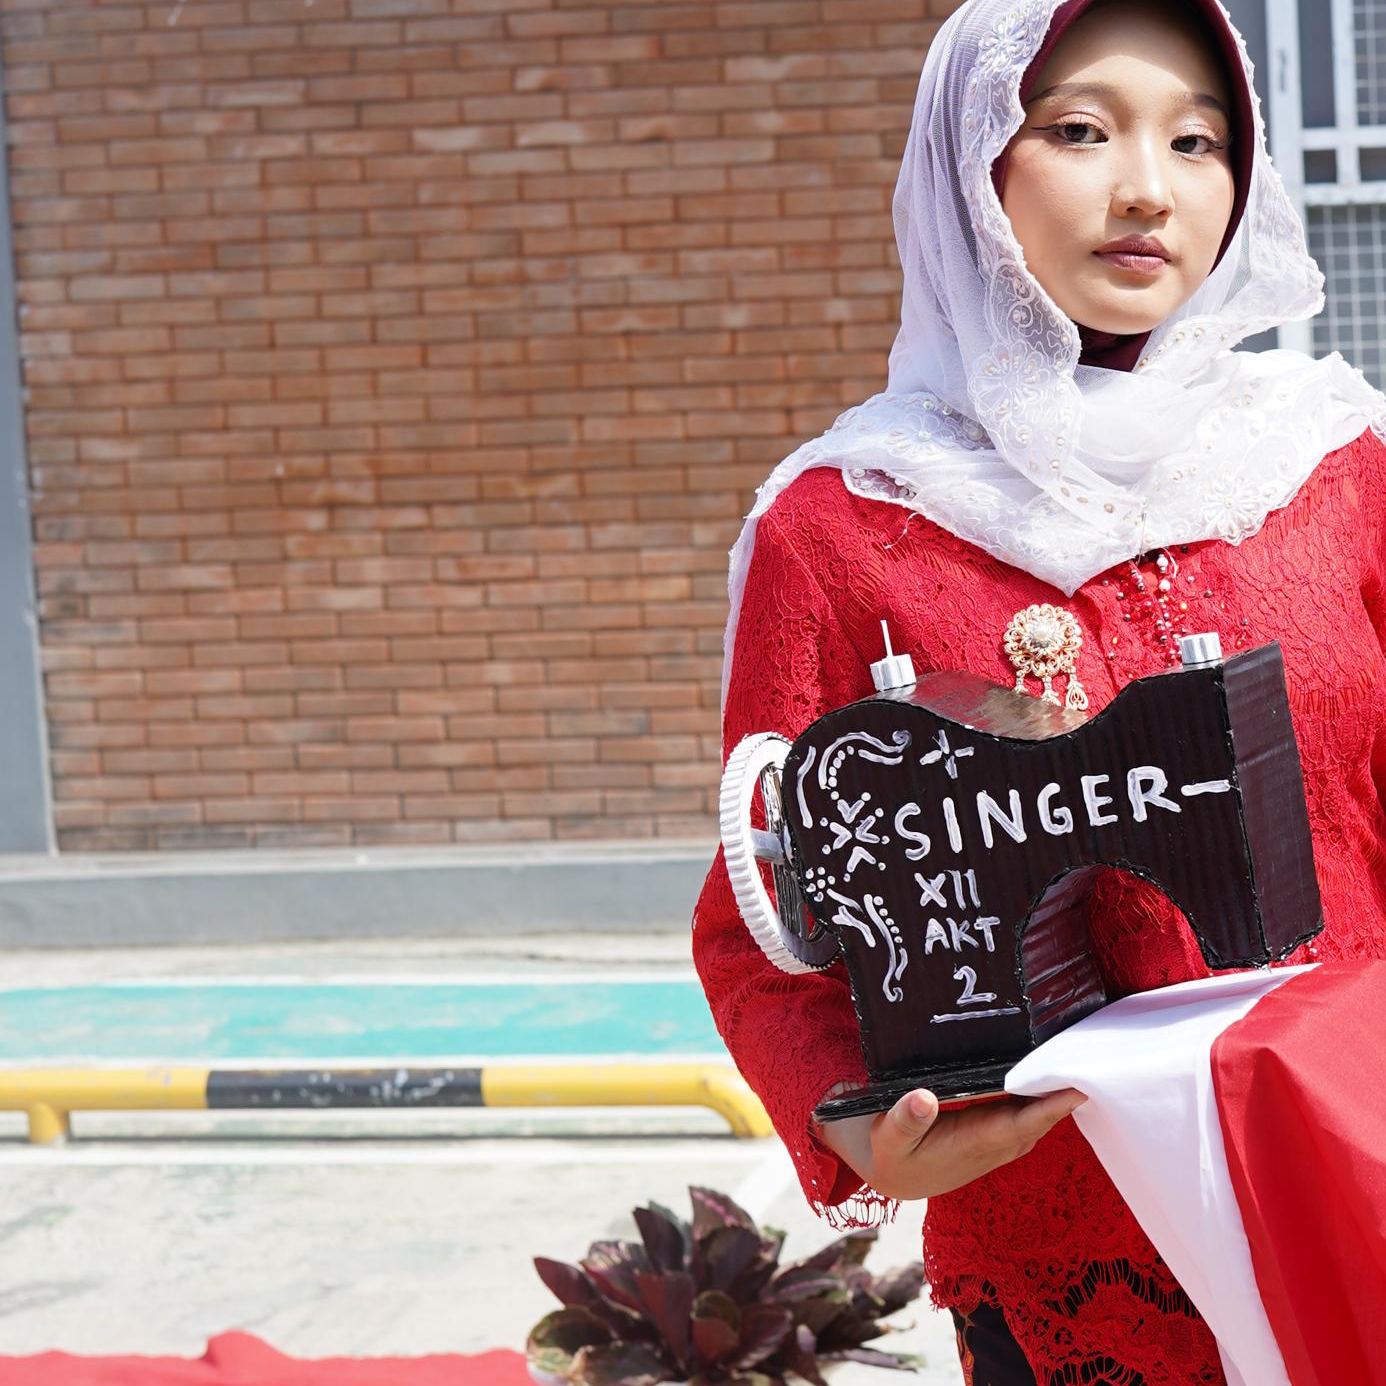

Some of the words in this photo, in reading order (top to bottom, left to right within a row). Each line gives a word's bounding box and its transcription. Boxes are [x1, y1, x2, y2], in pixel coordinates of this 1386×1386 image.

[913, 868, 978, 911] XII
[923, 915, 1001, 956] AKT
[952, 964, 998, 1006] 2
